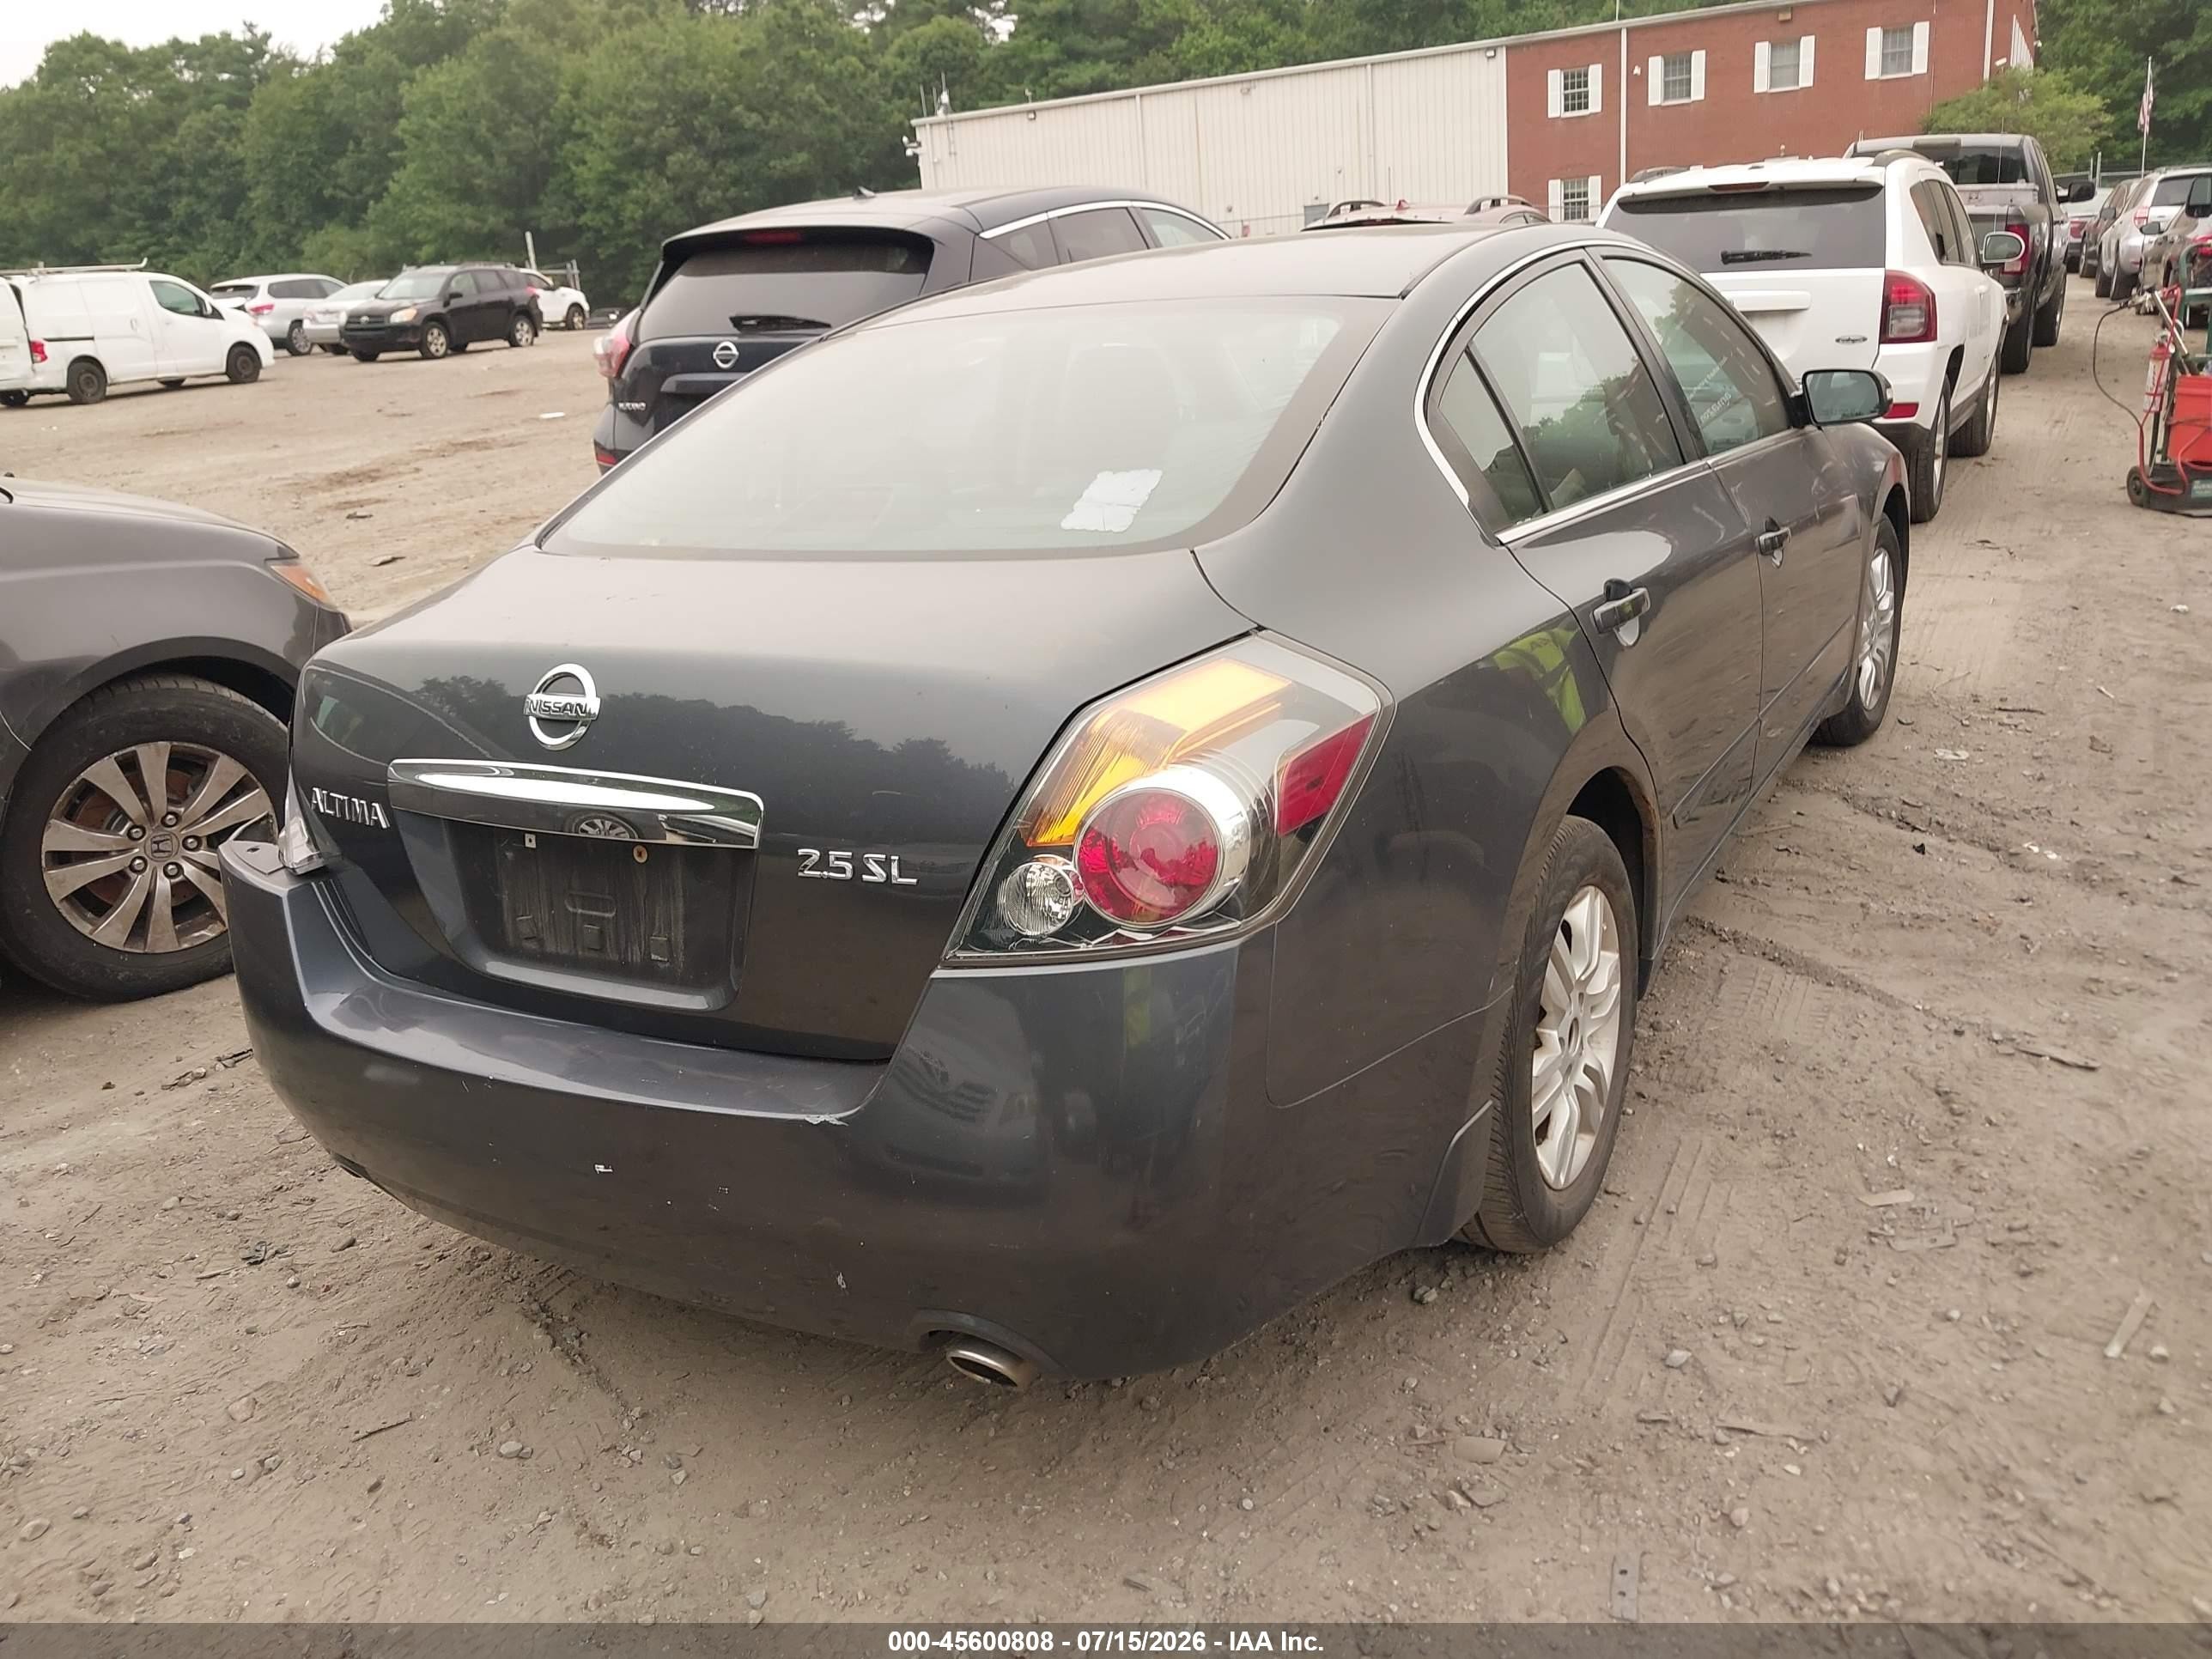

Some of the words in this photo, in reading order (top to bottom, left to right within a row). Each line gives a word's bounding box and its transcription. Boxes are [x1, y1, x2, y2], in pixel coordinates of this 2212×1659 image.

[526, 698, 588, 718] NISSAN
[311, 787, 391, 829] ALTIMA
[797, 848, 854, 880] 2.5
[861, 854, 919, 885] SL
